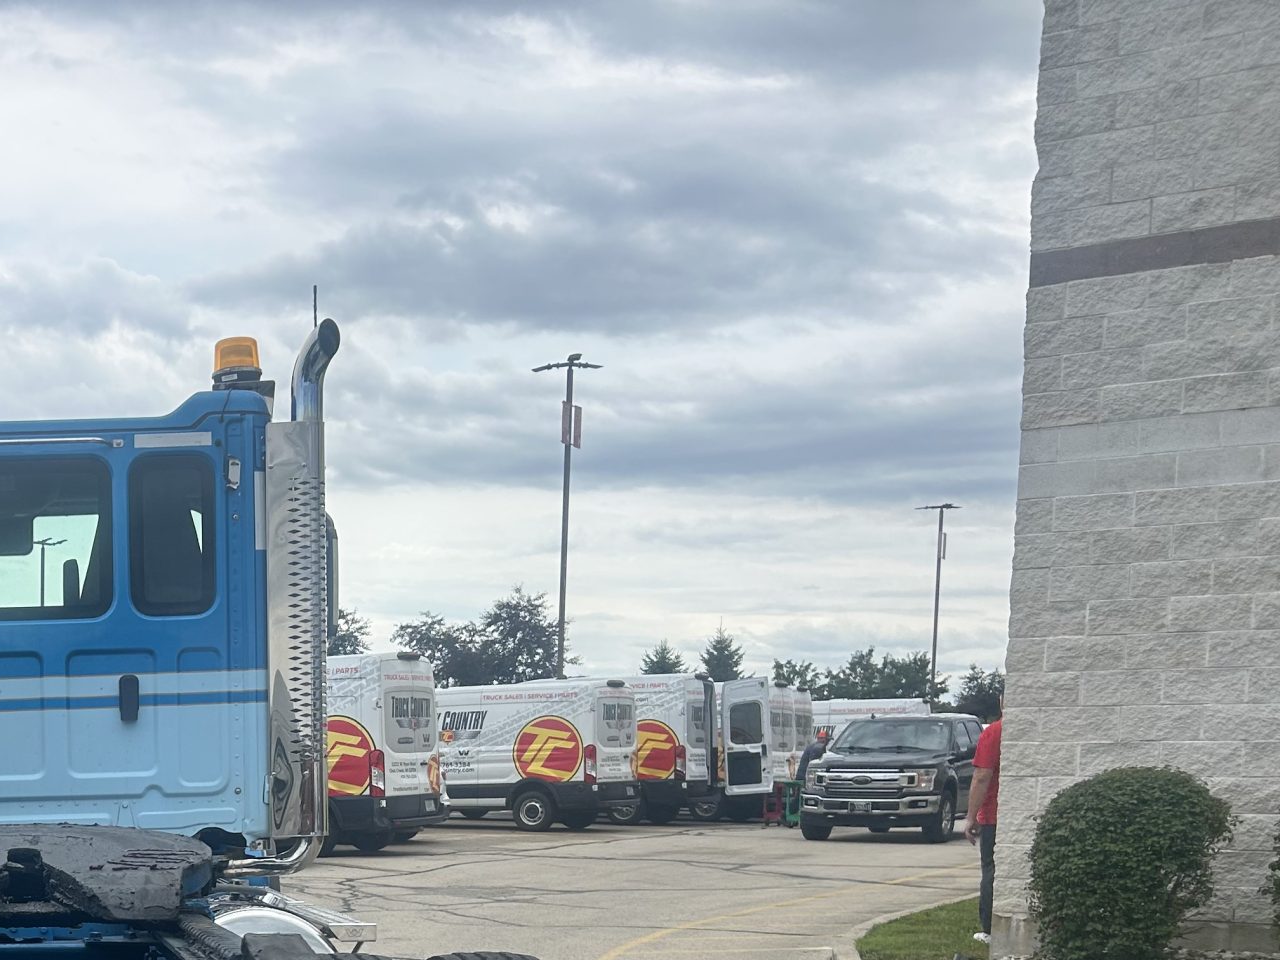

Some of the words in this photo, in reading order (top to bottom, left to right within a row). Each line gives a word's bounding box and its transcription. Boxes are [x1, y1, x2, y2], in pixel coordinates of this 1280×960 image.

[558, 691, 578, 699] PARTS
[391, 696, 409, 718] TRUCK
[410, 696, 431, 718] COUNTRY
[442, 710, 488, 731] COUNTRY
